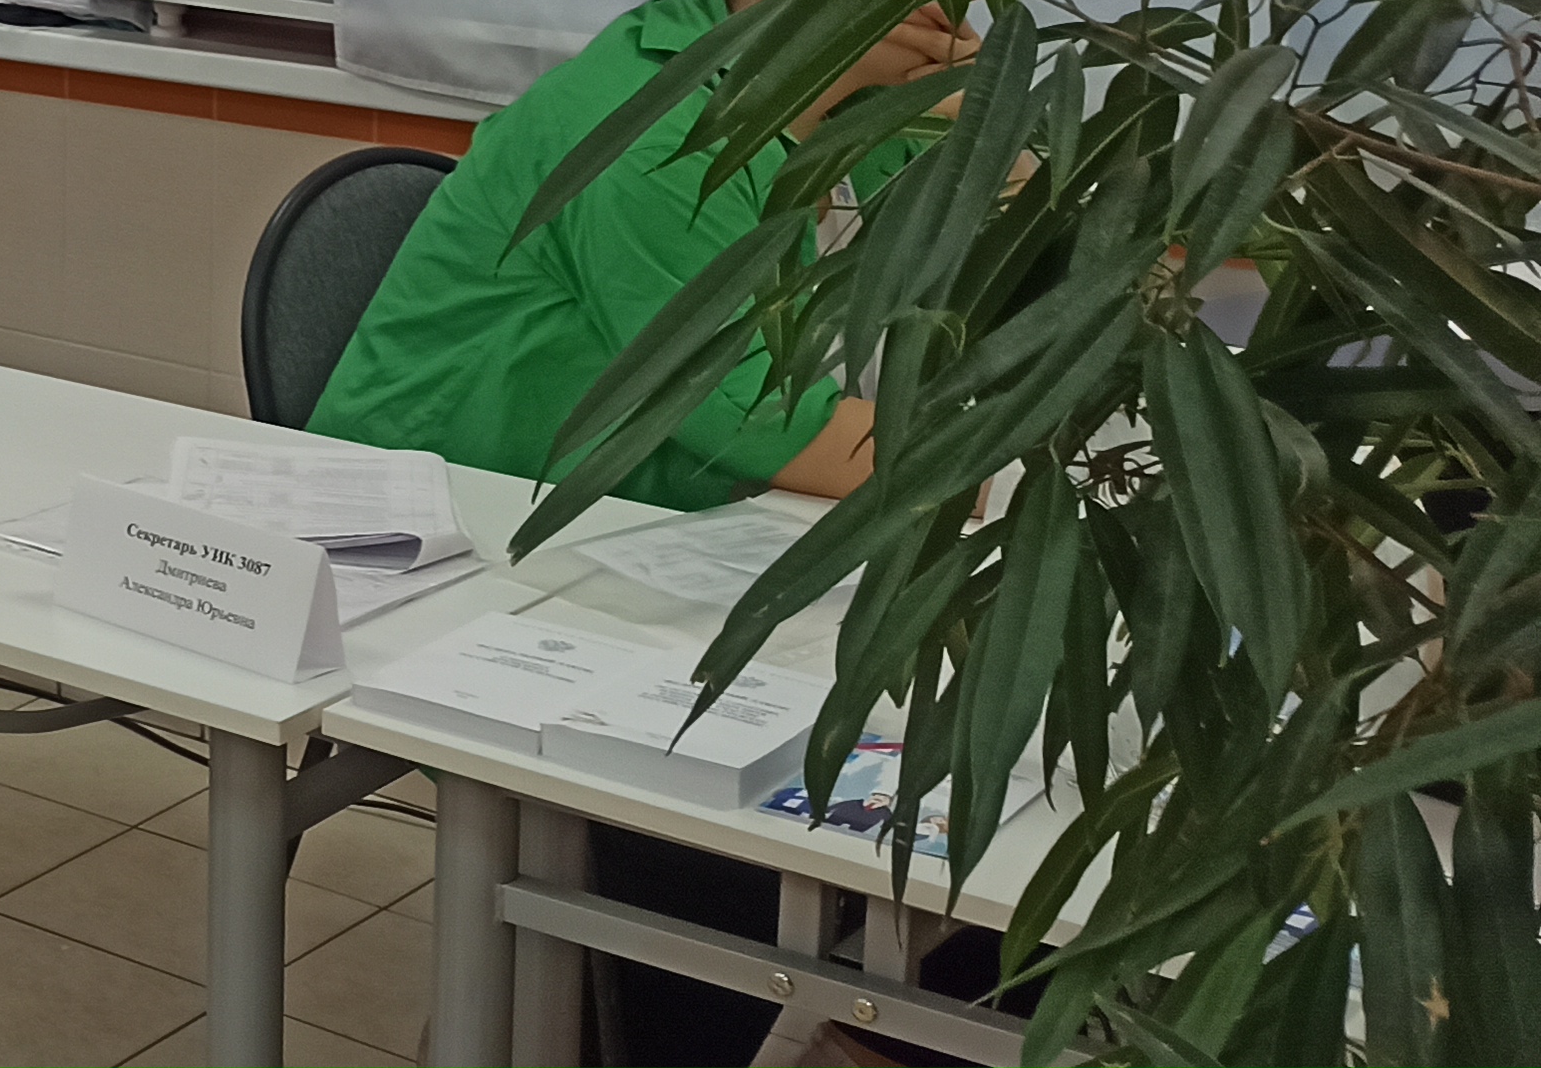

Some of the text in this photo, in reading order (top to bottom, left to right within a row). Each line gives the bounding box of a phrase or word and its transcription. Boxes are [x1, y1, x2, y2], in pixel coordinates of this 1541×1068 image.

[126, 523, 272, 577] Секретарь УИК 3087
[196, 598, 256, 630] Юрьевна
